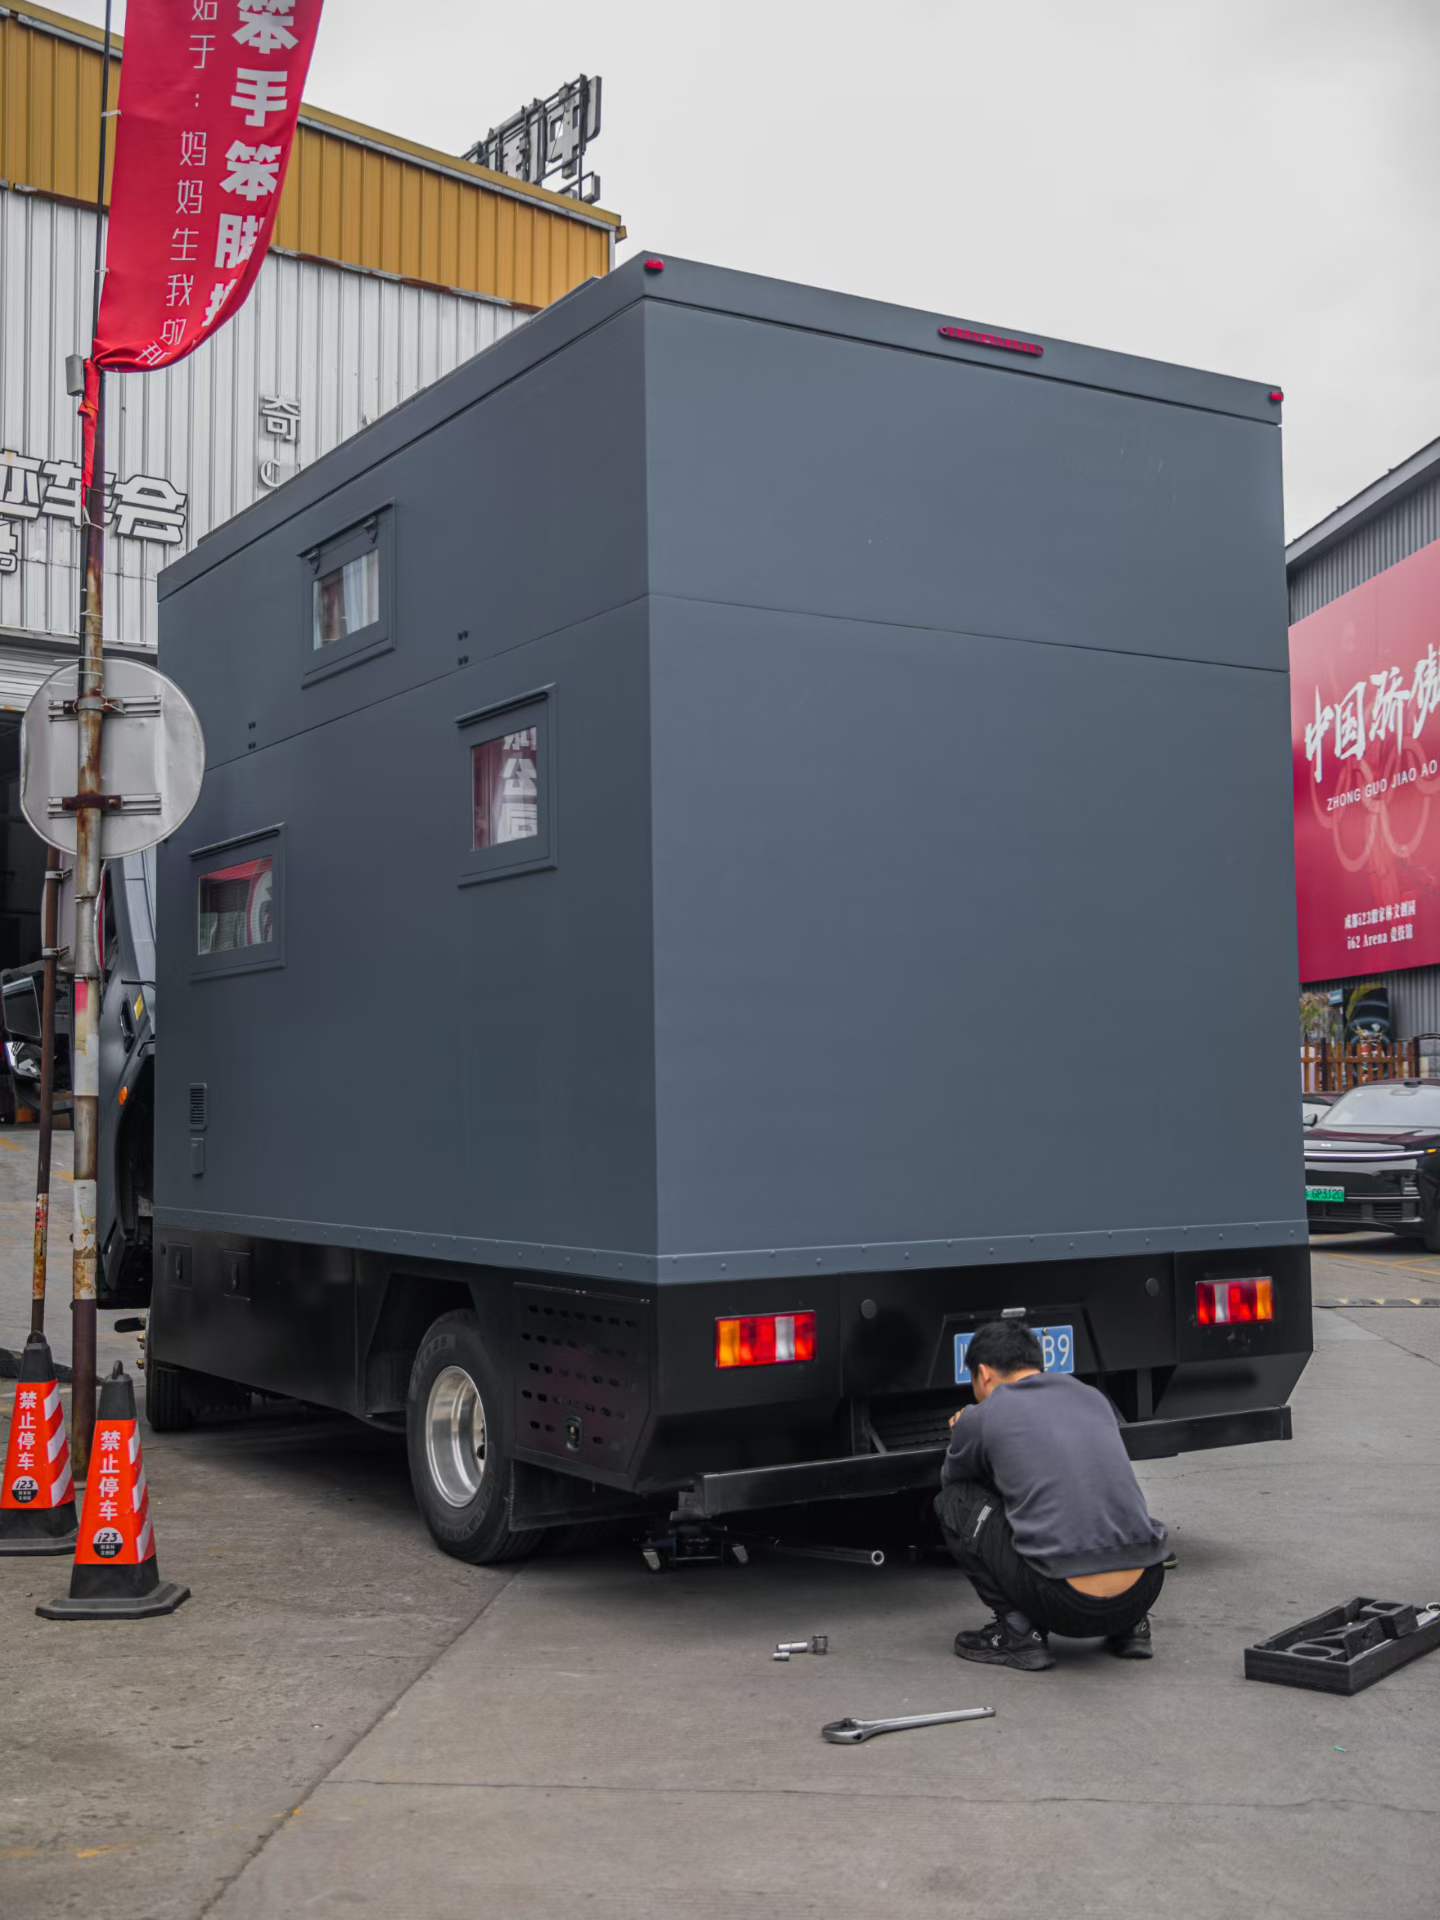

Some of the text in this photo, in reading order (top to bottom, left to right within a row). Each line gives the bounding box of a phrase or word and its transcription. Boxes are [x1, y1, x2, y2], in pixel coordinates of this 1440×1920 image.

[1326, 759, 1438, 811] ZHONG GUO JIAO AO
[17, 1391, 38, 1471] 禁止停车
[98, 1430, 121, 1522] 禁止停车
[97, 1532, 119, 1542] i23
